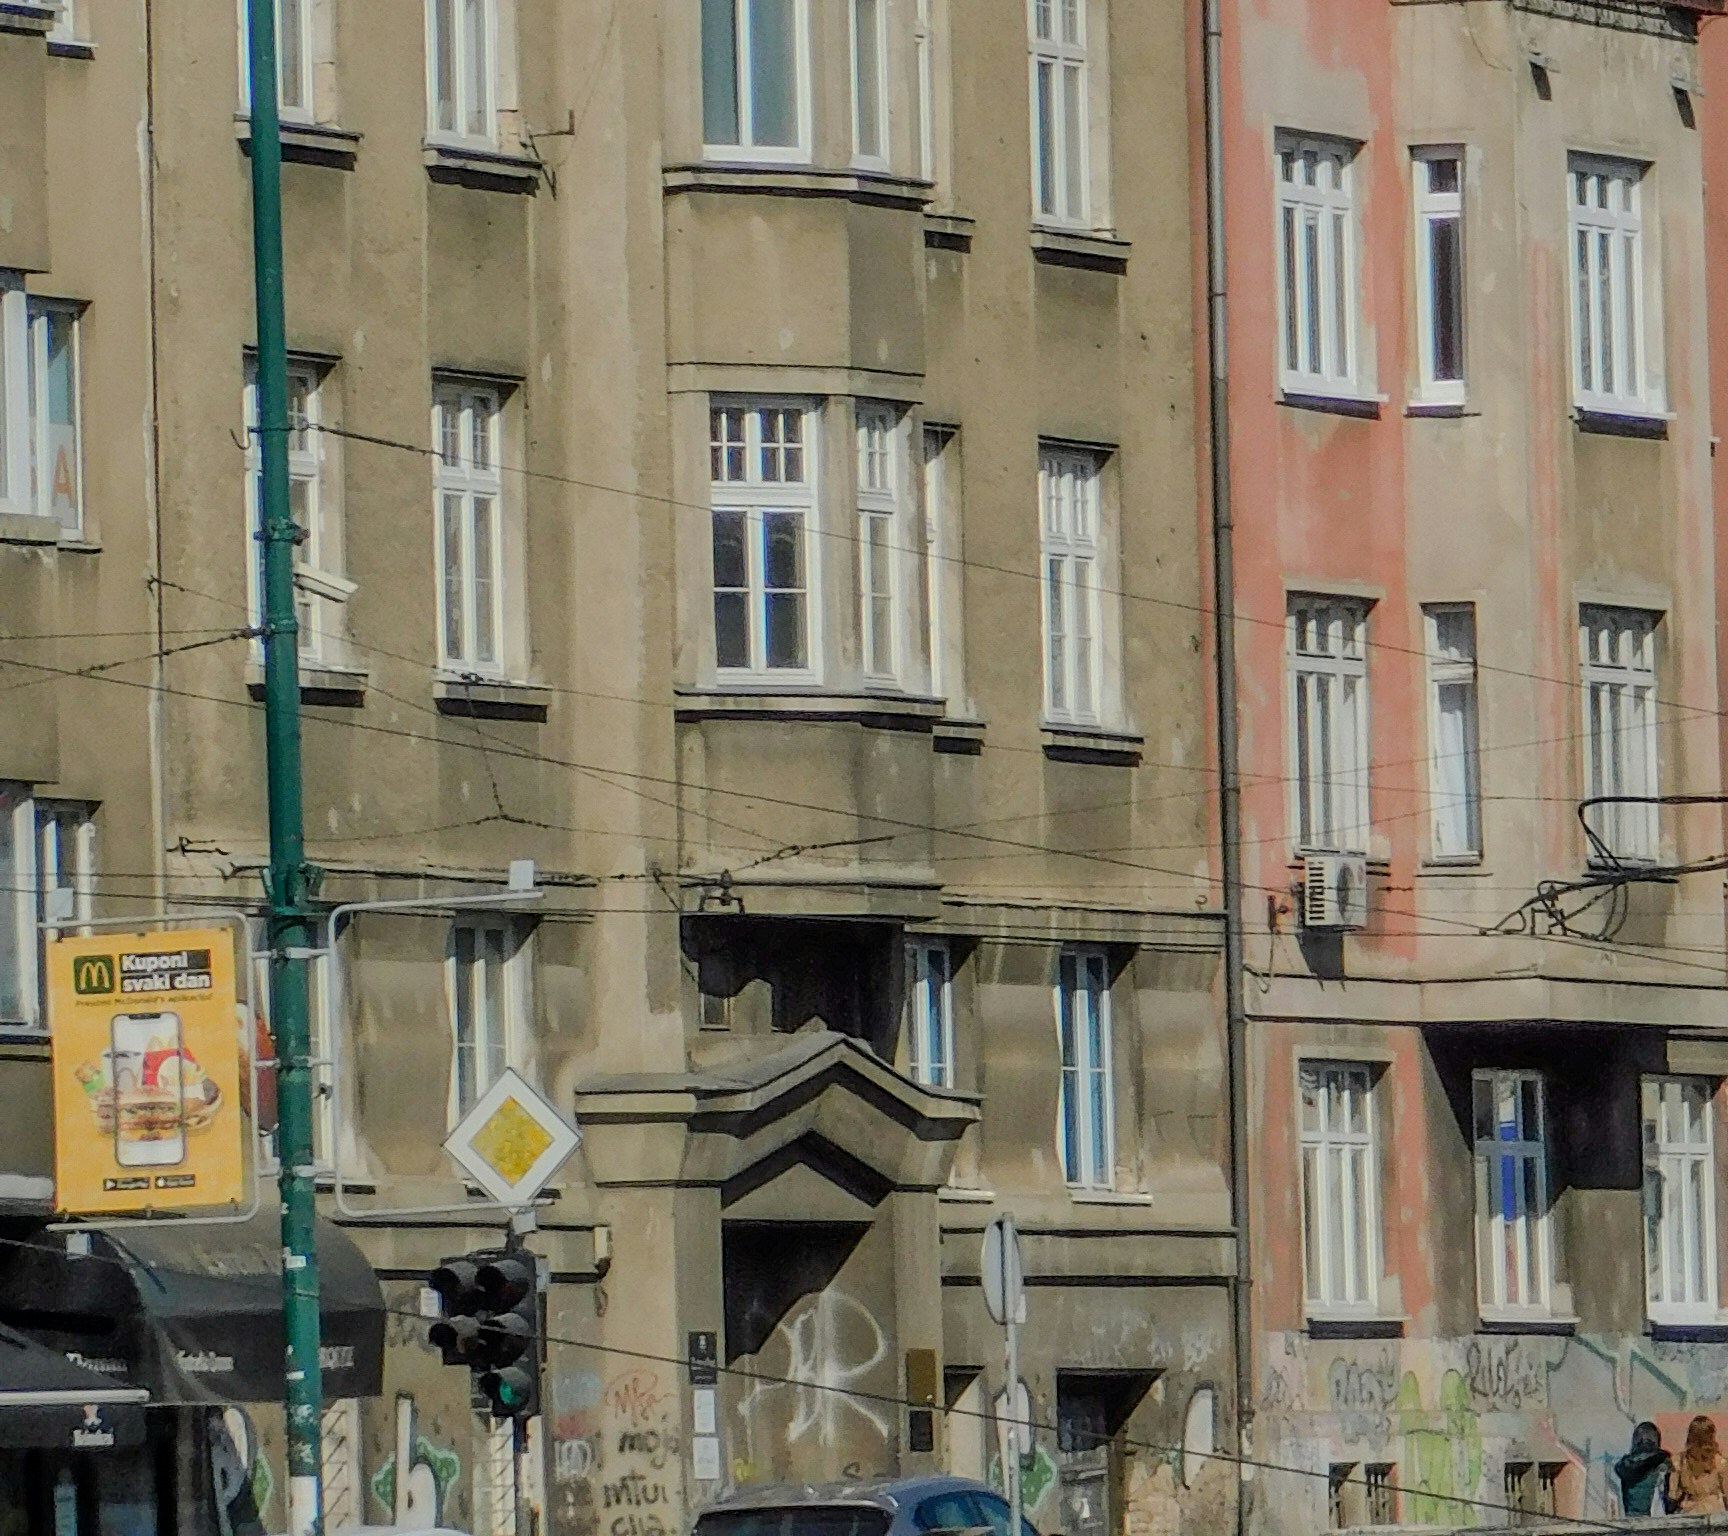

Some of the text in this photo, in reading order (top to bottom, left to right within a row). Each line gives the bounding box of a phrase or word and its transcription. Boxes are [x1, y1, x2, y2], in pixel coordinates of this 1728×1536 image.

[122, 951, 188, 971] Kuponi
[122, 972, 211, 992] svaki dan
